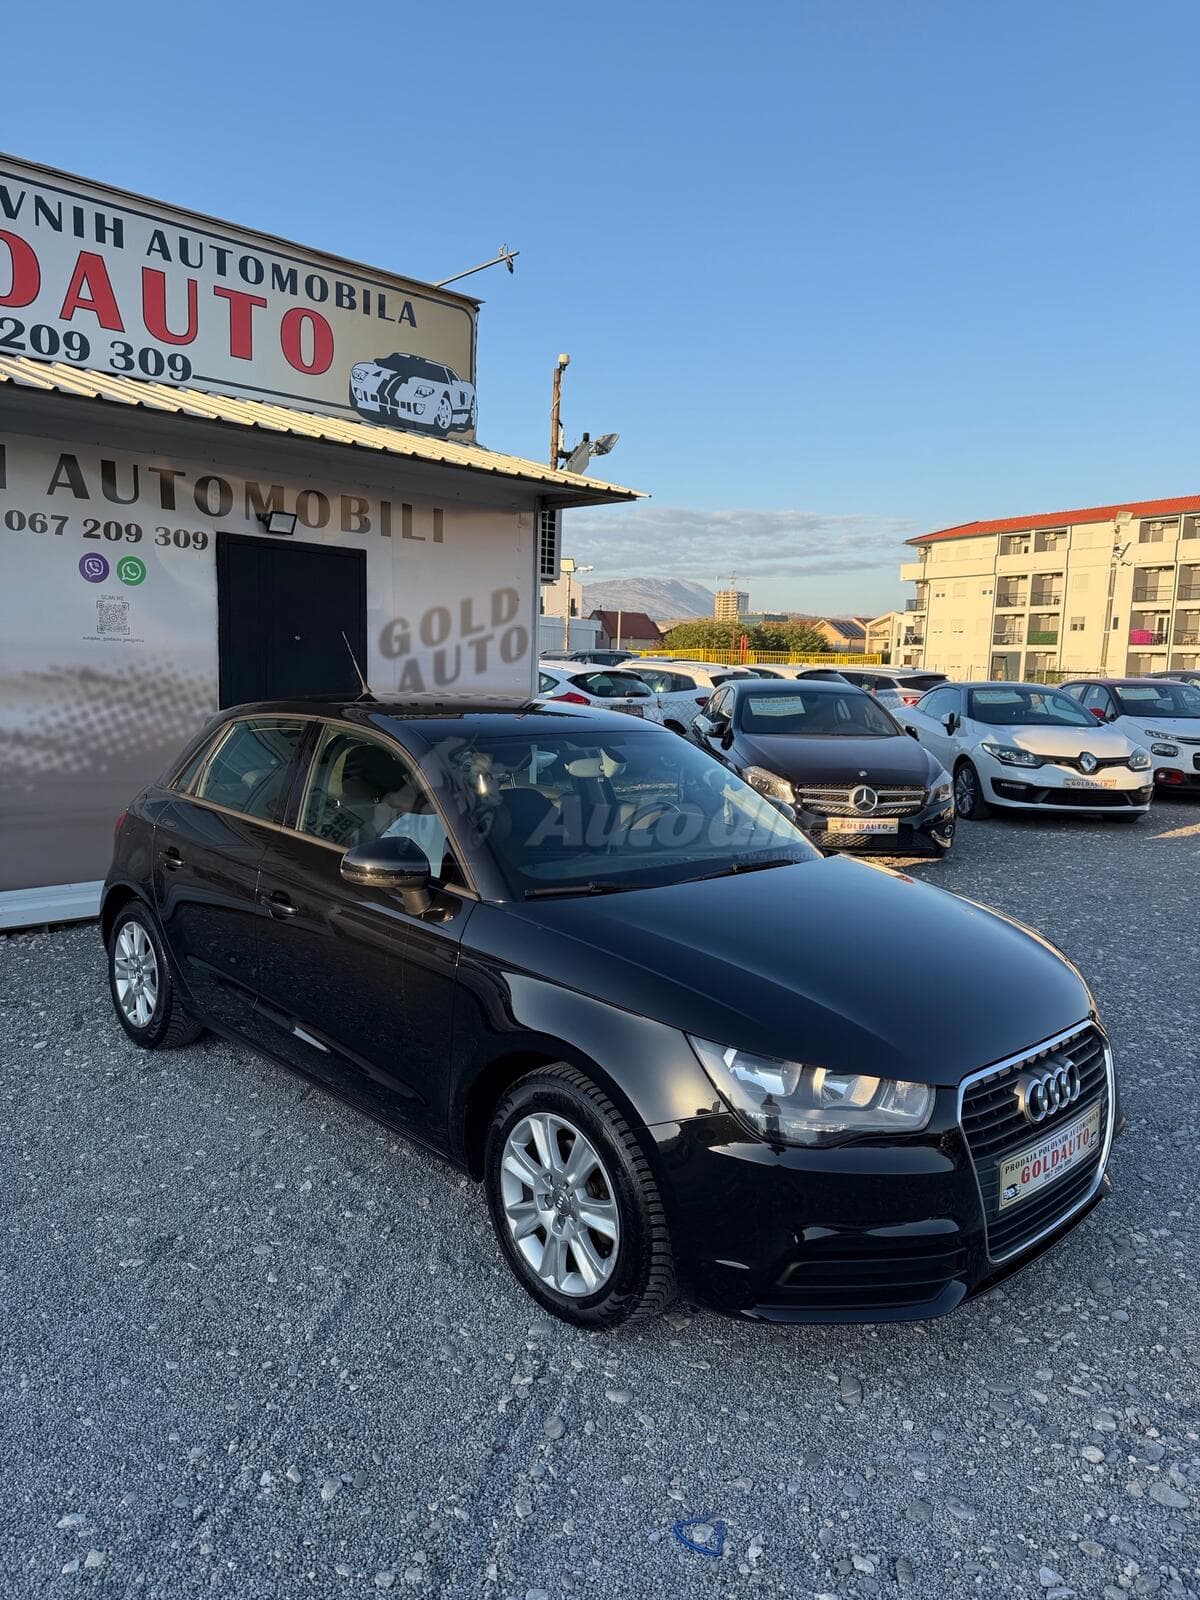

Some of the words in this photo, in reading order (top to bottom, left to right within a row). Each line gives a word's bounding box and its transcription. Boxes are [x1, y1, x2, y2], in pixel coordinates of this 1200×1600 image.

[146, 228, 418, 328] AUTOMOBILA
[0, 316, 90, 362] 209
[109, 340, 193, 382] 309
[4, 509, 69, 536] 067
[82, 518, 143, 543] 209
[155, 526, 208, 550] 309
[47, 453, 444, 544] AUTOMOBILI
[379, 587, 520, 660] GOLD
[398, 625, 529, 692] AUTO
[1005, 1153, 1037, 1174] PRODAJA
[1021, 1128, 1089, 1184] GOLDAUTO
